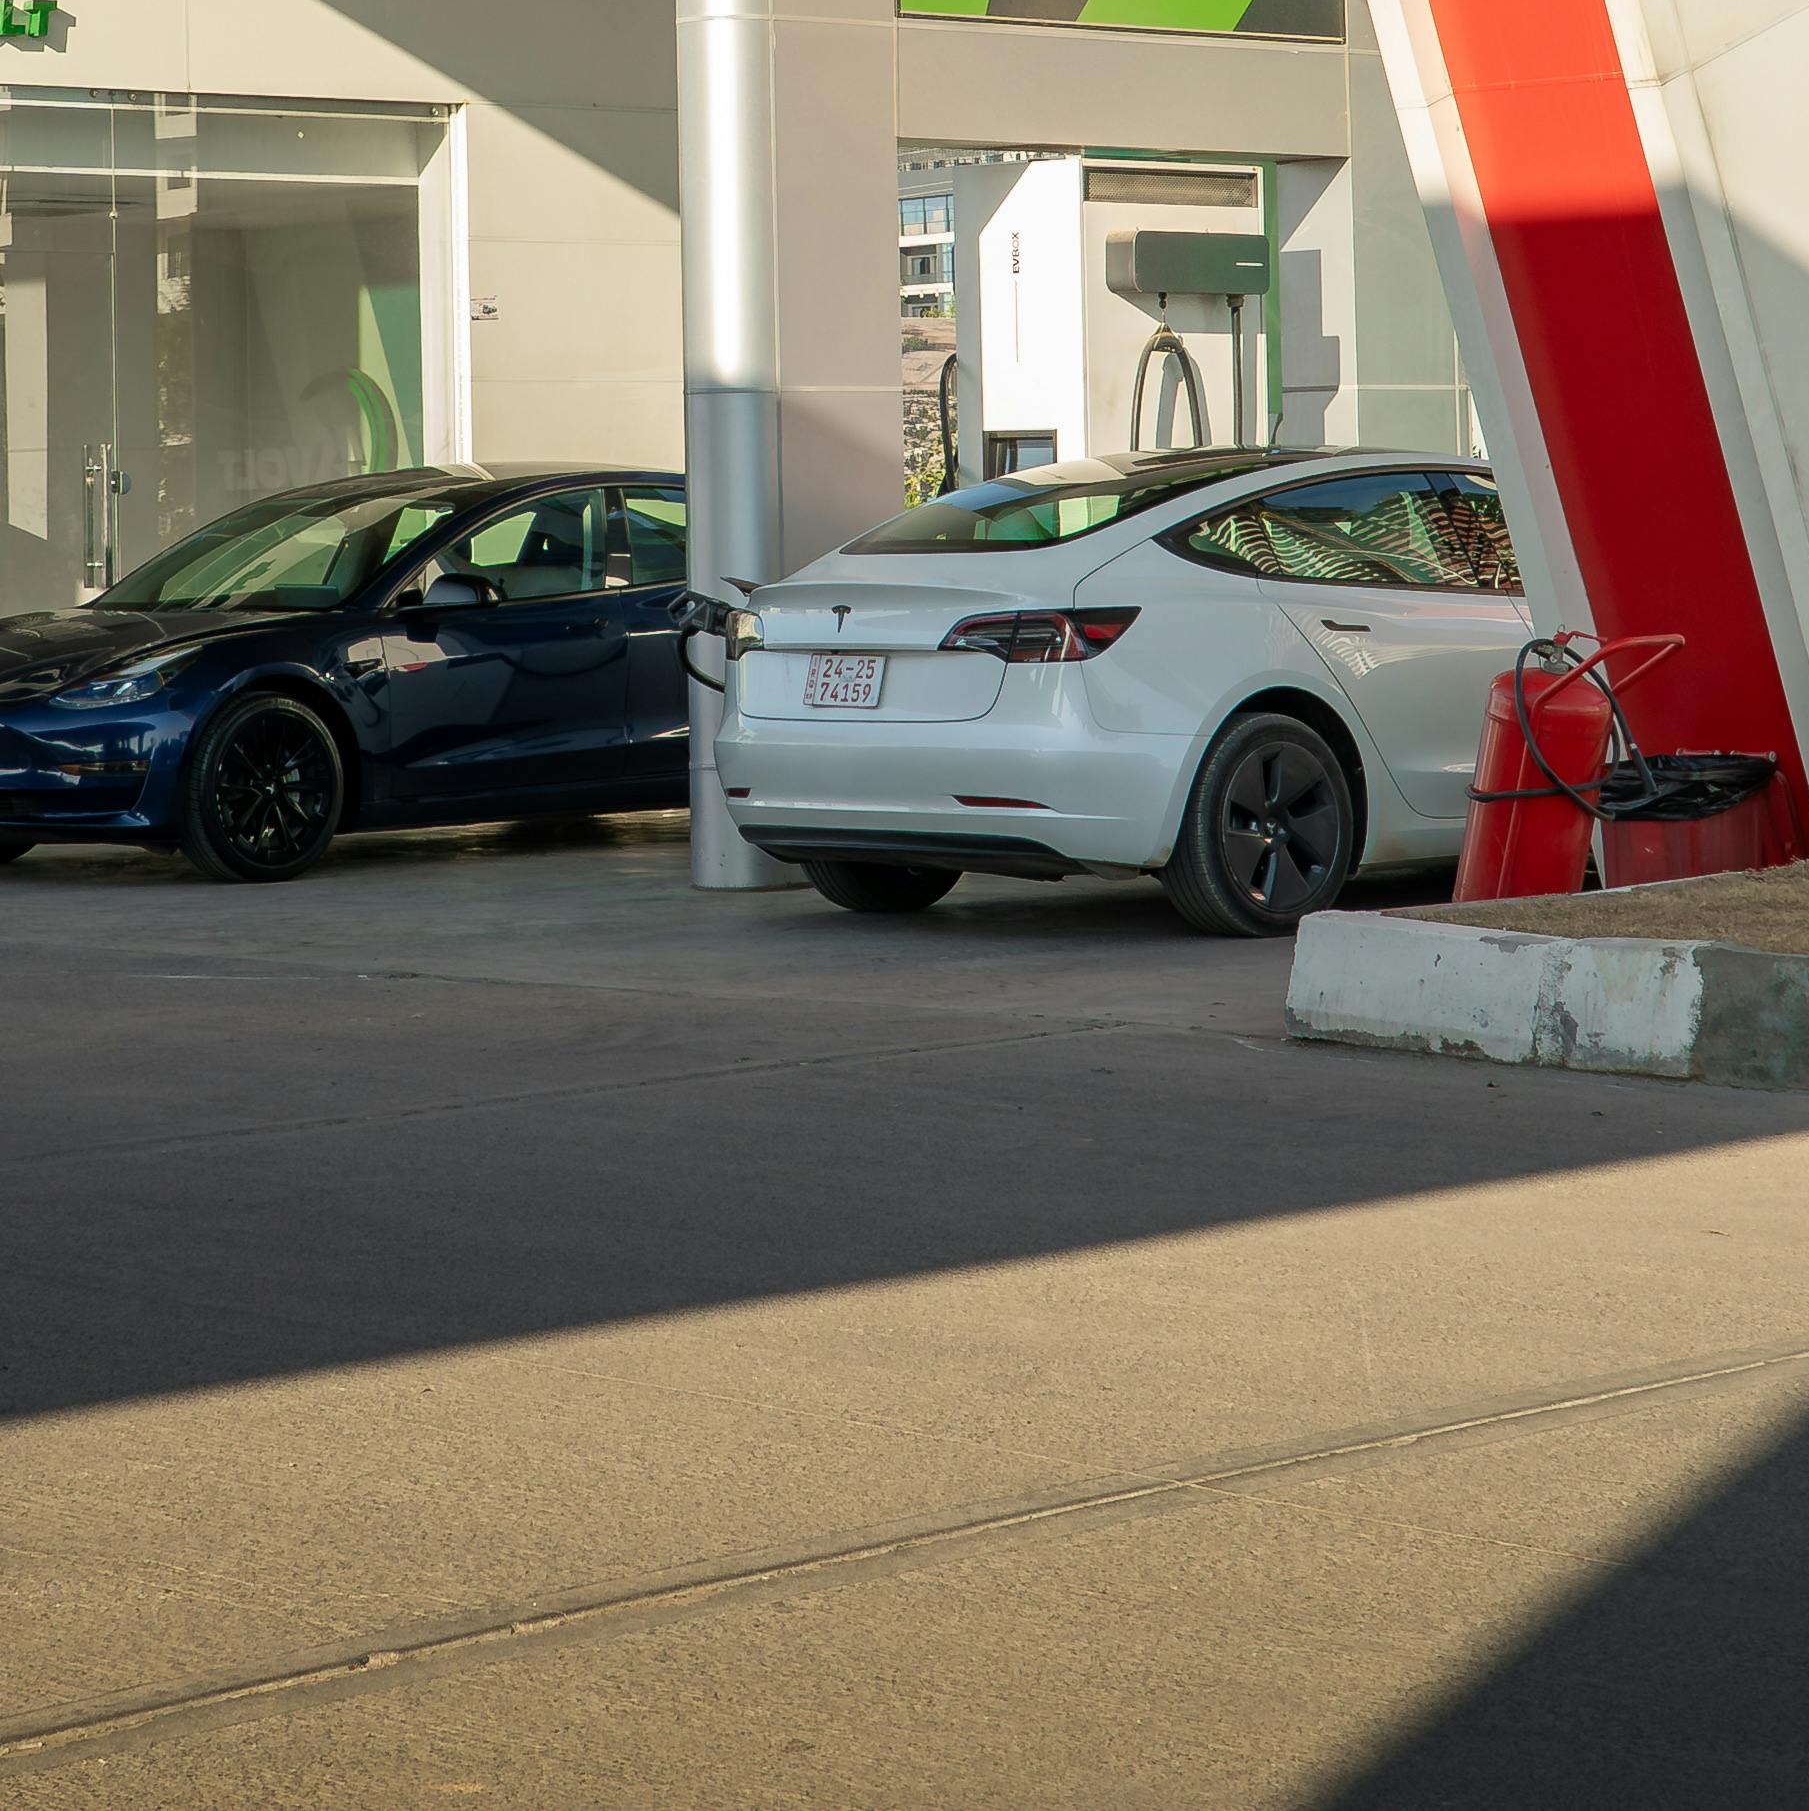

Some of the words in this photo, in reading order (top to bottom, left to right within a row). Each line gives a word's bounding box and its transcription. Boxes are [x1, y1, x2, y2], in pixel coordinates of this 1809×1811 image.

[1011, 231, 1020, 274] EVBOX
[822, 658, 877, 680] 24-25
[819, 682, 872, 703] 74159
